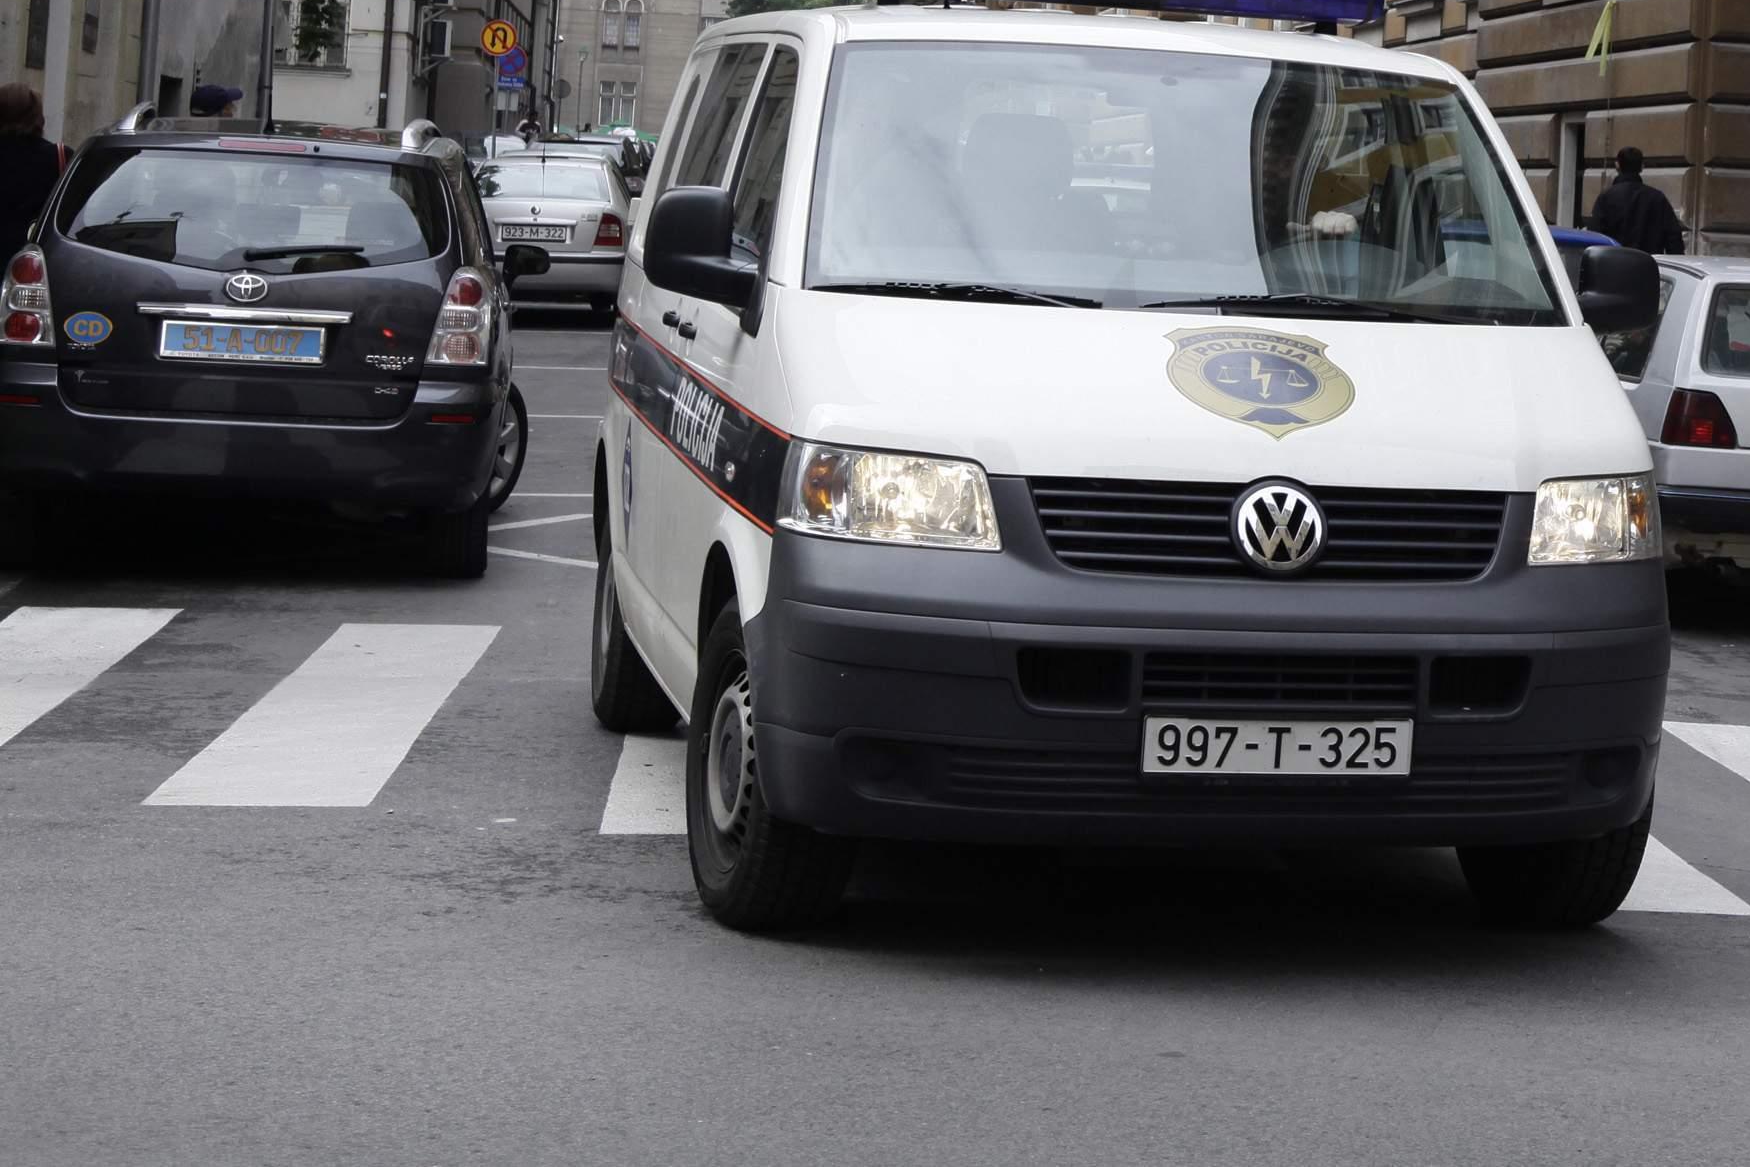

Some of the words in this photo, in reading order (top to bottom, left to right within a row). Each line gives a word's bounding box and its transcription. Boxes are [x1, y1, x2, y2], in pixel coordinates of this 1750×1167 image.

[504, 226, 565, 239] 923-M-322
[73, 319, 105, 338] CD
[182, 325, 304, 354] 51-A-007
[1192, 340, 1309, 363] POLICIJA
[670, 377, 726, 472] POLICIJA
[1156, 723, 1397, 769] 997-T-325
